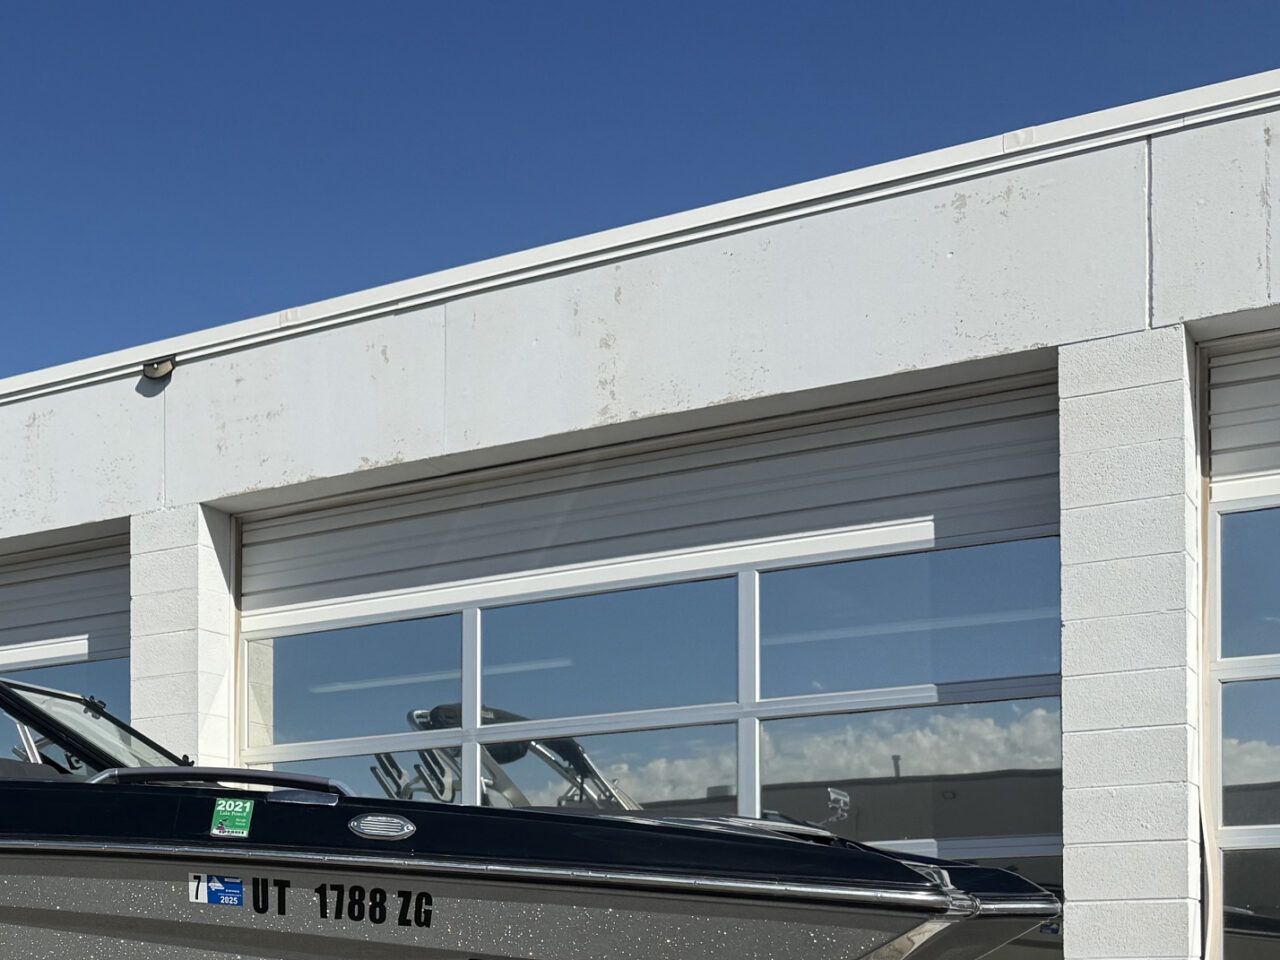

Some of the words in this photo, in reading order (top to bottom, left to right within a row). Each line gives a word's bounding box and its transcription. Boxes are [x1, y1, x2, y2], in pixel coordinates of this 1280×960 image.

[216, 800, 251, 813] 2021
[193, 875, 202, 900] 7
[220, 896, 239, 905] 2025
[251, 877, 291, 916] UT
[314, 883, 387, 924] 1788
[397, 890, 433, 928] ZG
